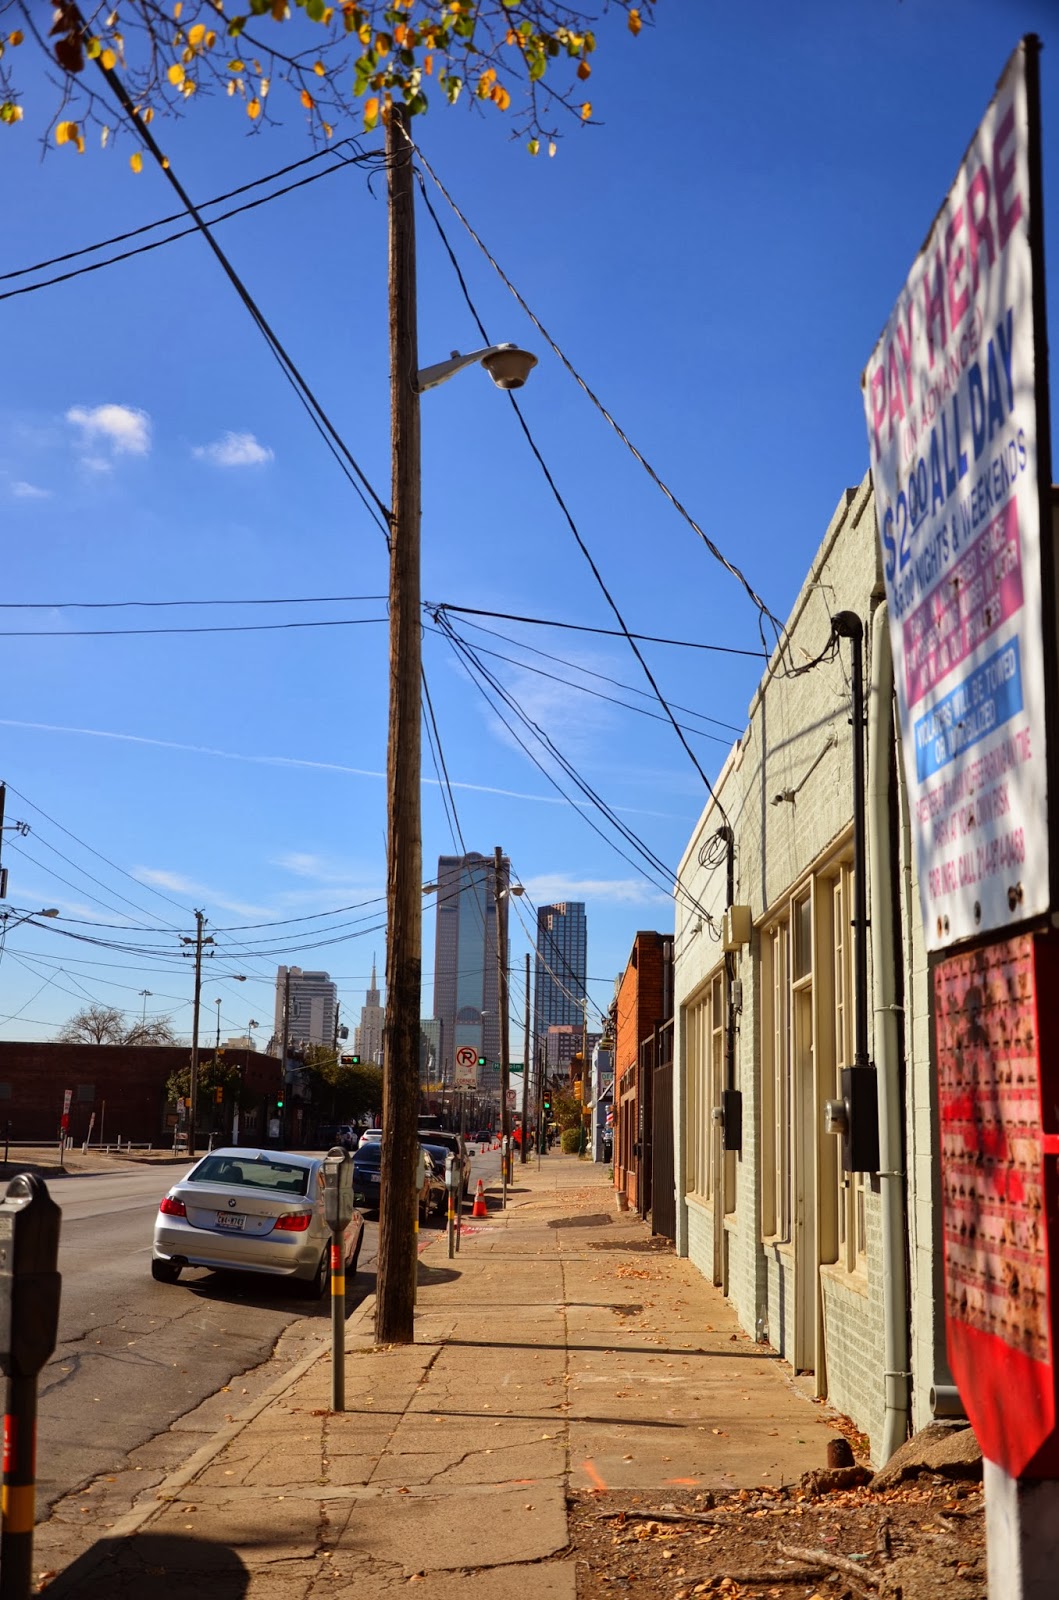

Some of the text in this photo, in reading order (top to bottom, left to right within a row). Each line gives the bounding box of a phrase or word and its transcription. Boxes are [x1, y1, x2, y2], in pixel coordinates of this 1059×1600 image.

[872, 101, 1022, 462] PAY HERE
[930, 392, 968, 518] ALL
[968, 307, 1015, 463] DAY
[915, 524, 949, 590] NIGHTS
[952, 515, 959, 551] &
[960, 427, 1027, 538] WEEKENDS
[985, 645, 1015, 695] TOWED
